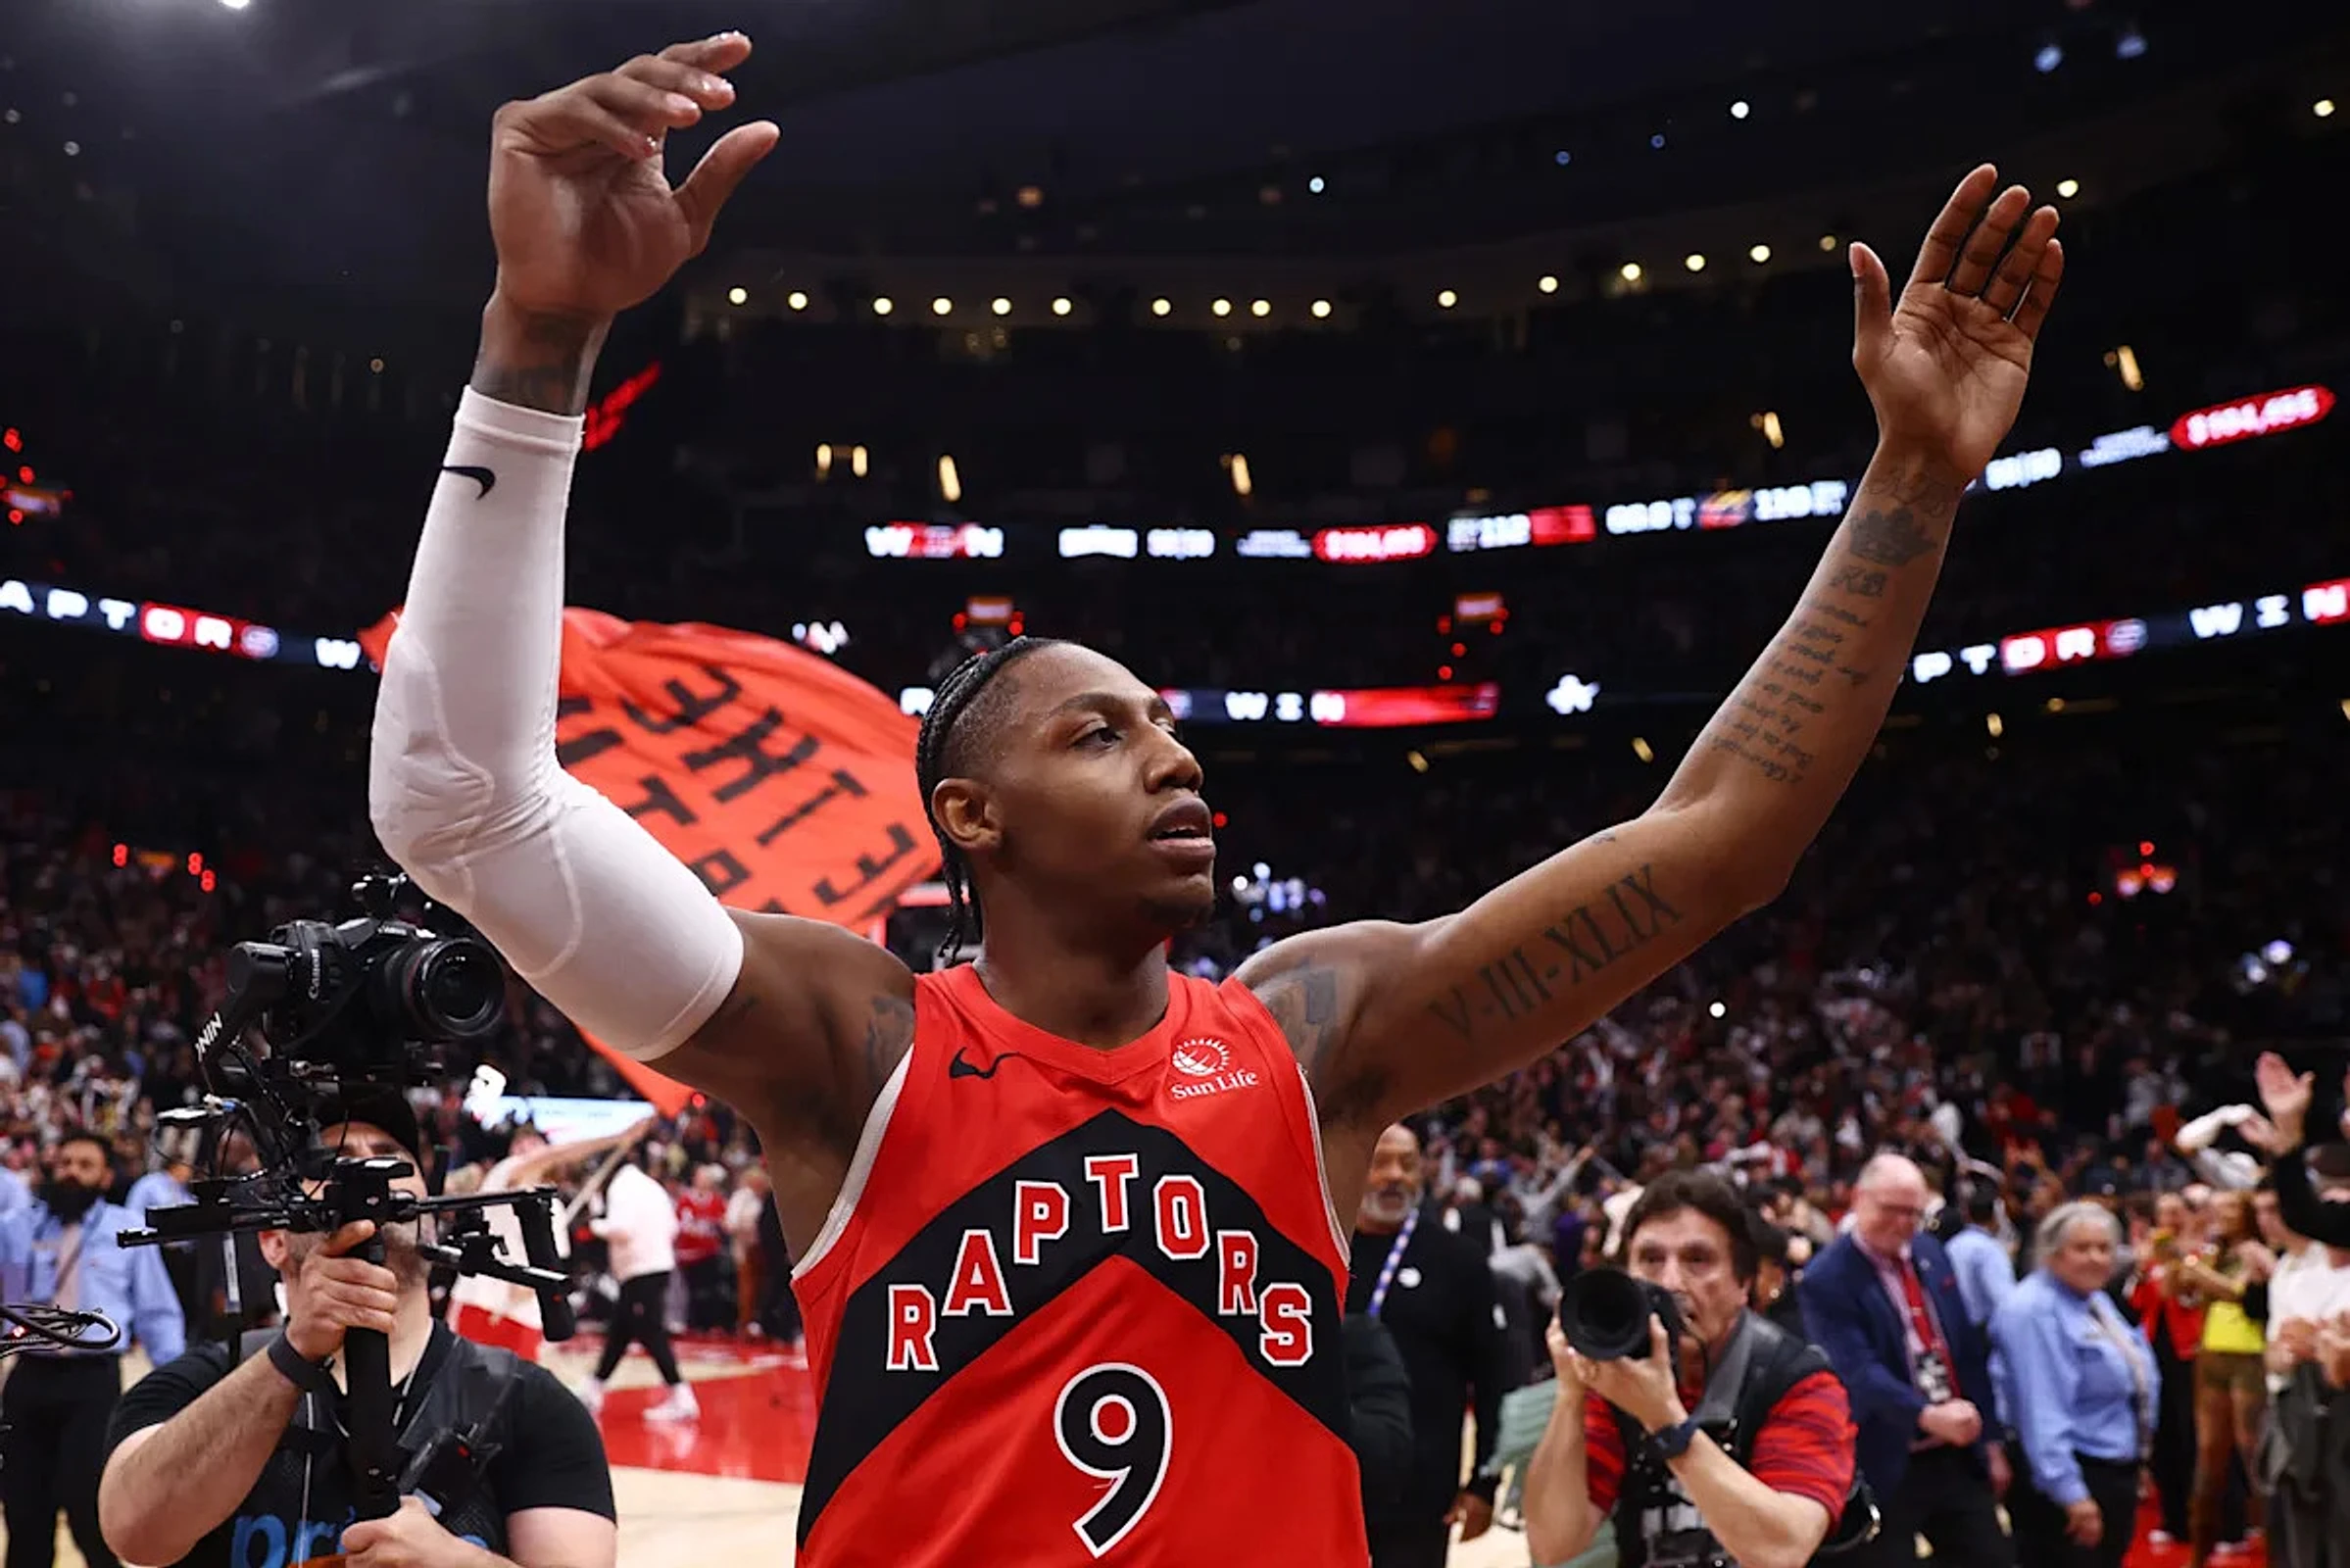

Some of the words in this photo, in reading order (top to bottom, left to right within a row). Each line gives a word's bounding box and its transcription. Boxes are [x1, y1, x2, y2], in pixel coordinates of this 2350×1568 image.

[1170, 1081, 1217, 1102] Sun
[1215, 1068, 1259, 1091] Life
[886, 1152, 1312, 1371] RAPTORS
[1053, 1362, 1173, 1558] 9
